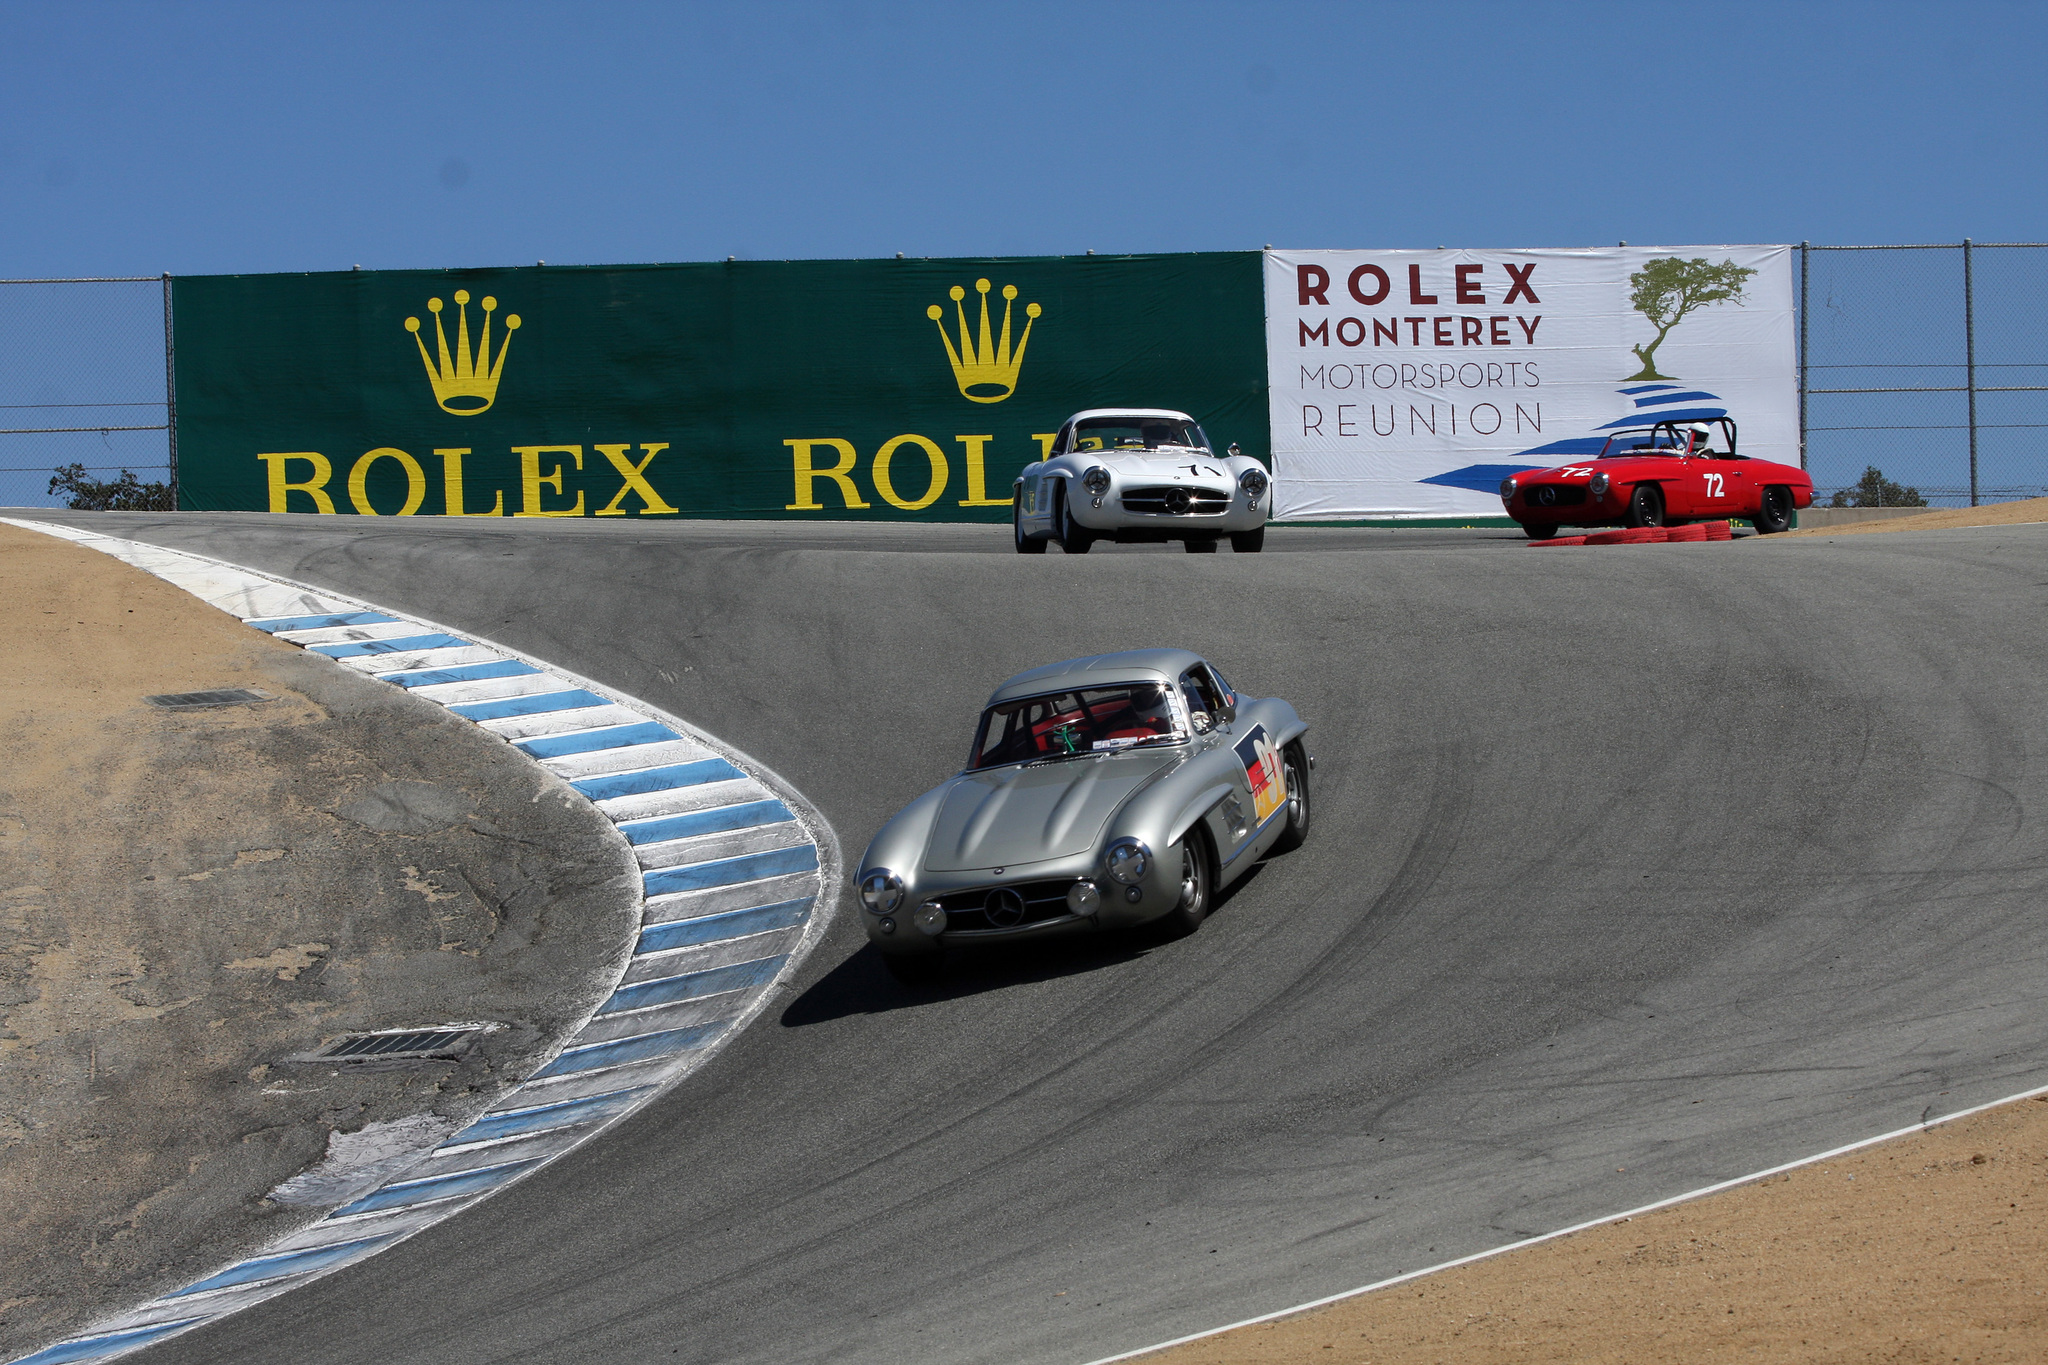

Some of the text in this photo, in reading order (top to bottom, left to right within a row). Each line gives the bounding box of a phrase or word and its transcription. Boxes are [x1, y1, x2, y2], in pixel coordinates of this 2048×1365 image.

[1297, 263, 1541, 306] ROLEX
[1298, 315, 1542, 347] MONTEREY
[1300, 361, 1540, 389] MOTORSPORTS
[1302, 402, 1541, 437] REUNION
[257, 442, 679, 517] ROLEX
[1561, 467, 1594, 478] 72
[1703, 473, 1725, 498] 72
